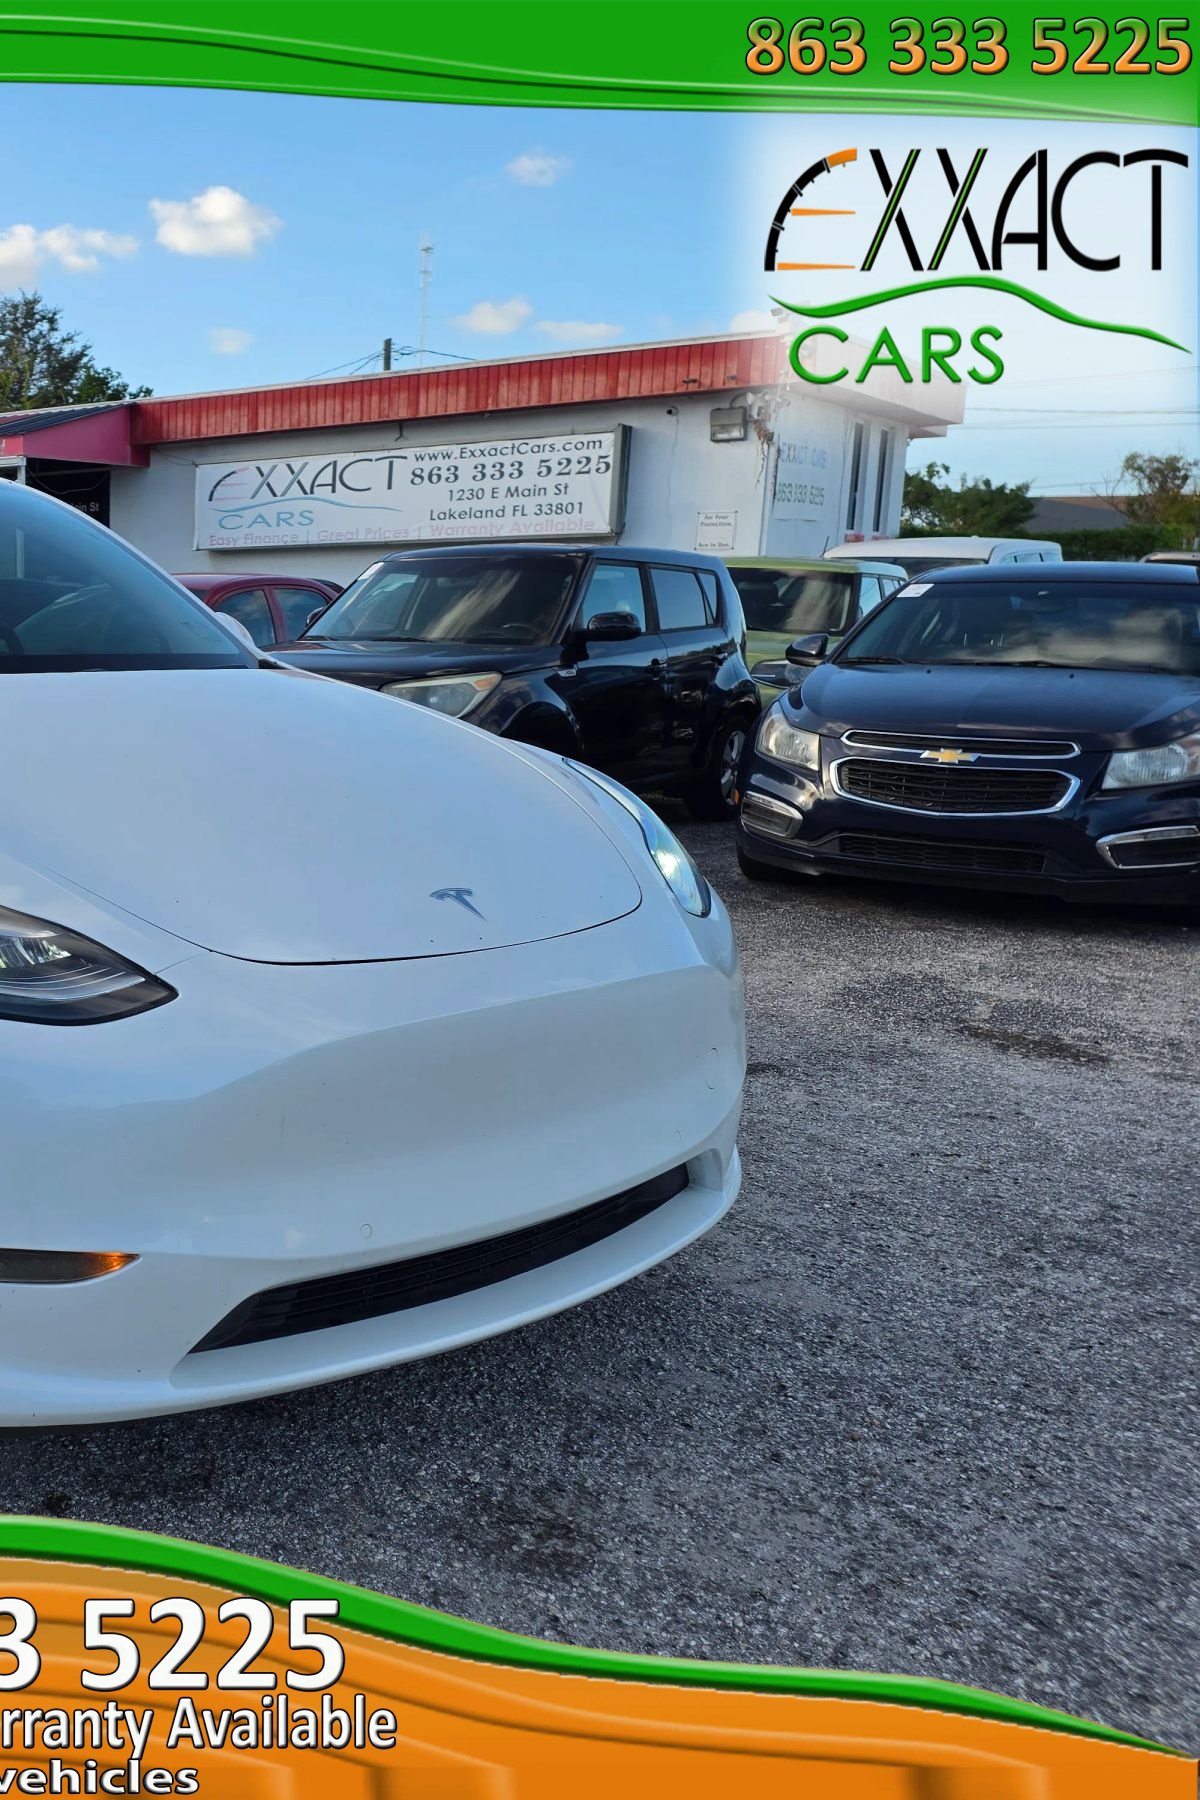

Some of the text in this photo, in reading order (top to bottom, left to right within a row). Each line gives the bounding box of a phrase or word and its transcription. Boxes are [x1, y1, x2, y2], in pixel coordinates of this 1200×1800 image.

[414, 439, 603, 462] www.ExxactCars.com
[208, 455, 408, 502] EXXACT
[410, 454, 611, 486] 863 333 5225
[448, 482, 569, 502] 1230 E Main St
[218, 510, 315, 530] CARS
[429, 502, 583, 521] Lakeland FL 33801
[209, 534, 239, 547] Easy
[318, 528, 359, 542] Great
[363, 526, 410, 540] Prices
[429, 521, 504, 538] Warranty
[510, 517, 595, 534] Available
